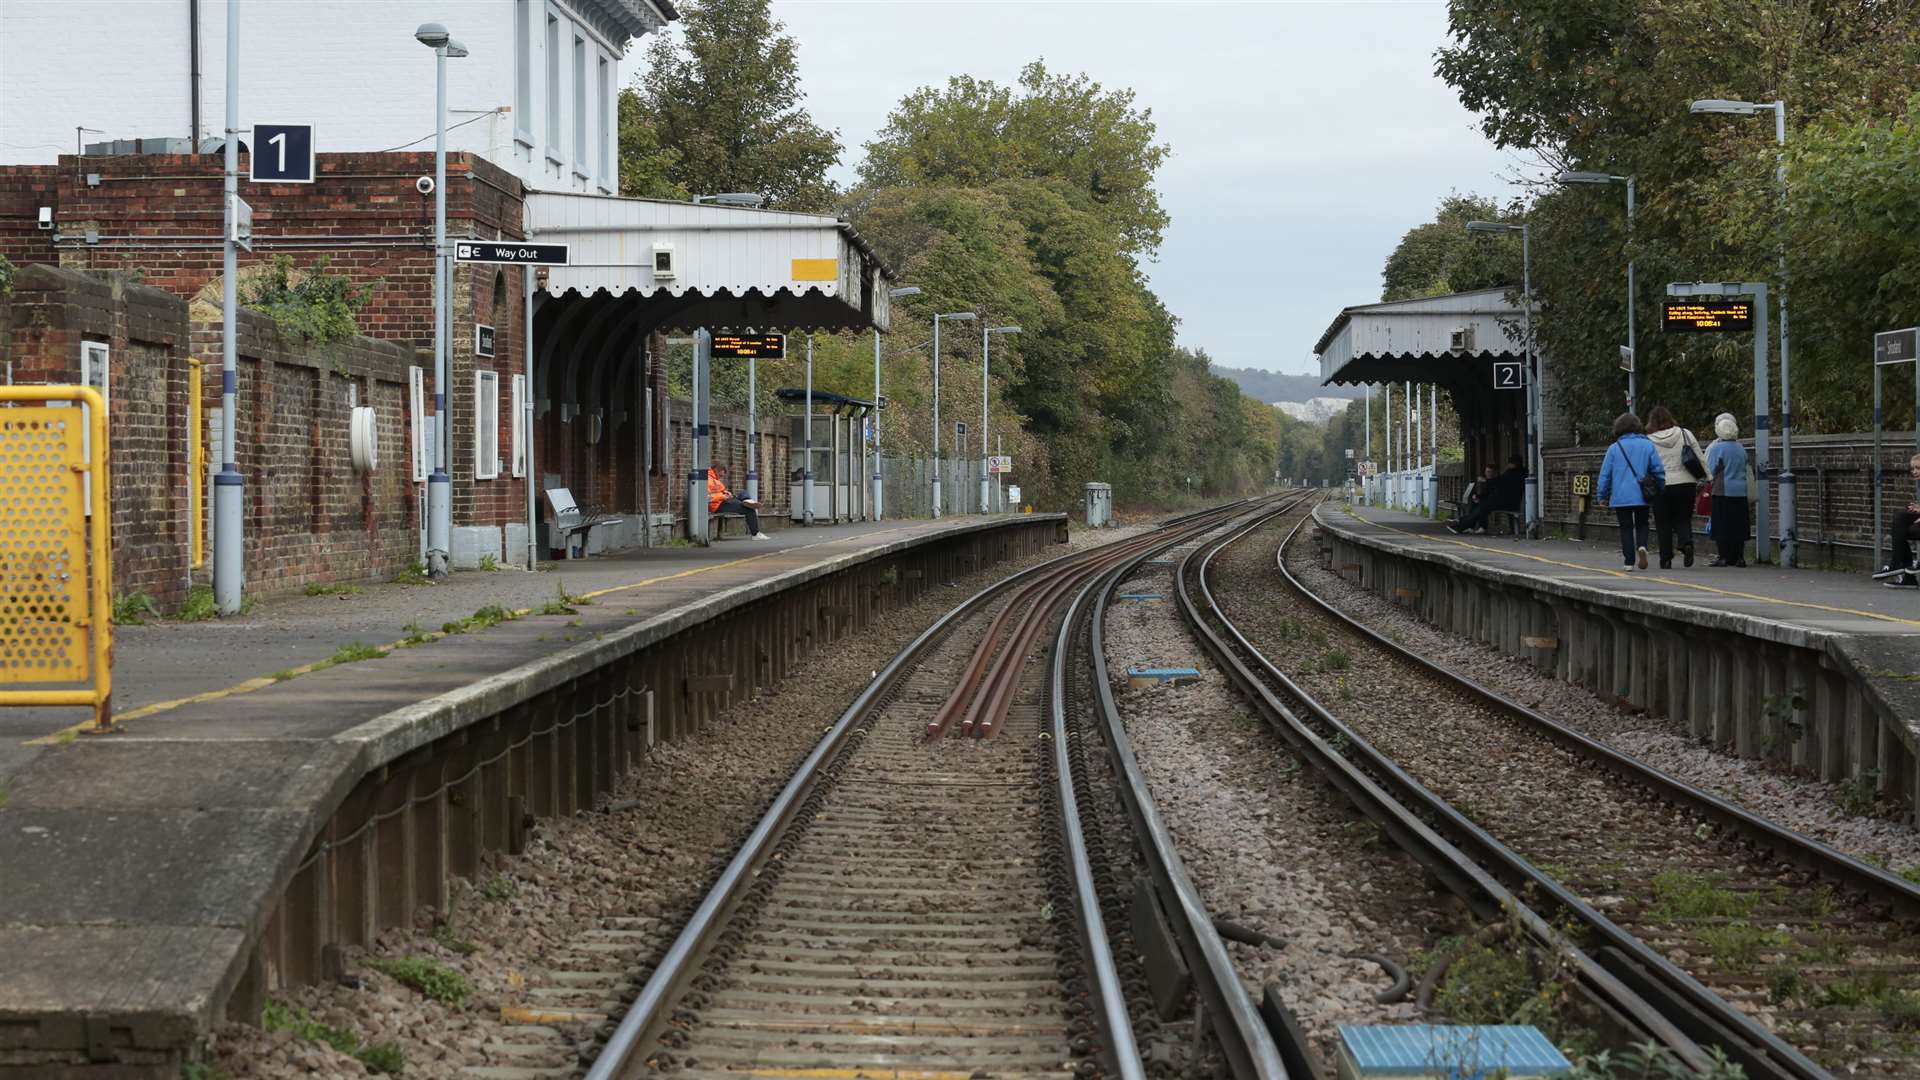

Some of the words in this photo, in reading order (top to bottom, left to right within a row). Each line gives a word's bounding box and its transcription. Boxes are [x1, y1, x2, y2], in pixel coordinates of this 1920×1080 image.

[268, 133, 286, 172] 1
[495, 247, 516, 260] Way
[518, 249, 538, 259] Out
[1502, 367, 1514, 384] 2
[1575, 477, 1588, 488] 36
